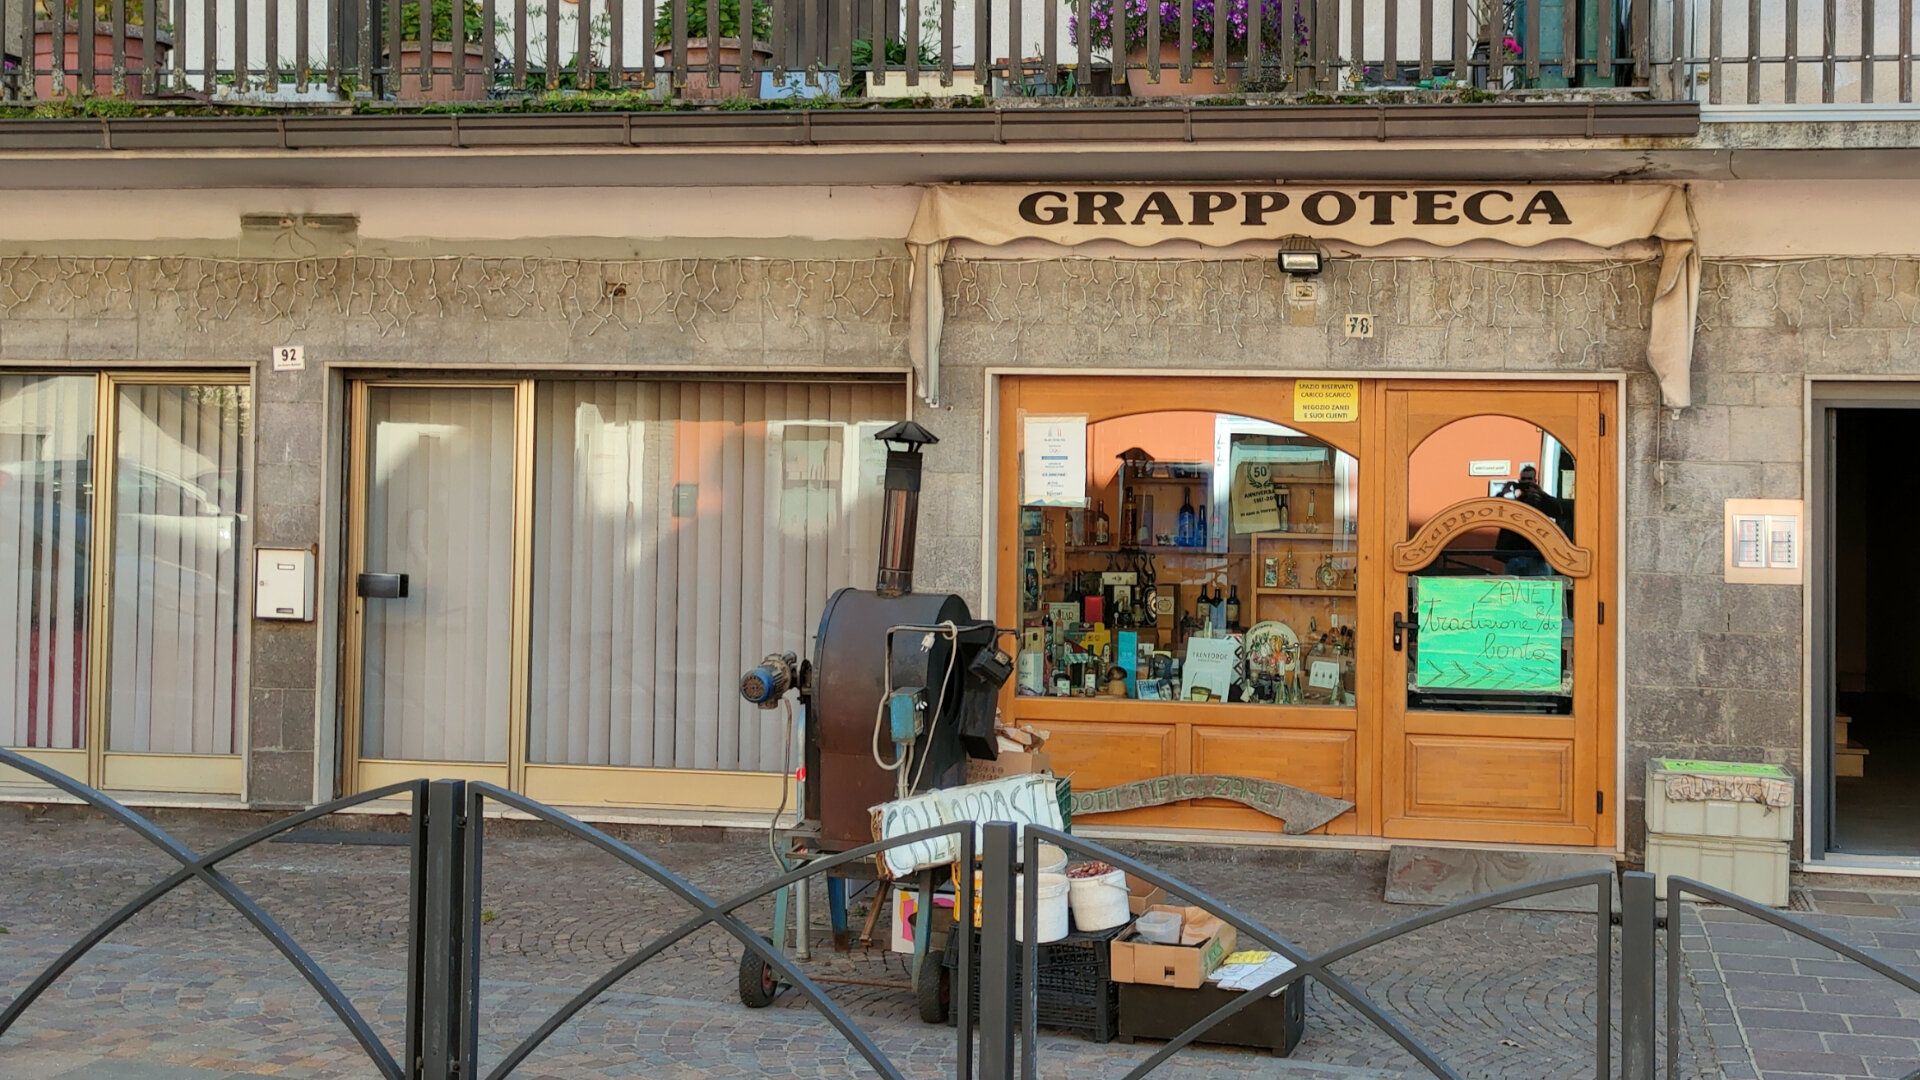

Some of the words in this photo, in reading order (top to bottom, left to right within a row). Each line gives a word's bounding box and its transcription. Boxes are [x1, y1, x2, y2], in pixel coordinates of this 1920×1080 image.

[1018, 189, 1573, 226] GRAPPOTECA
[281, 348, 297, 361] 92
[1421, 598, 1532, 632] tradizione
